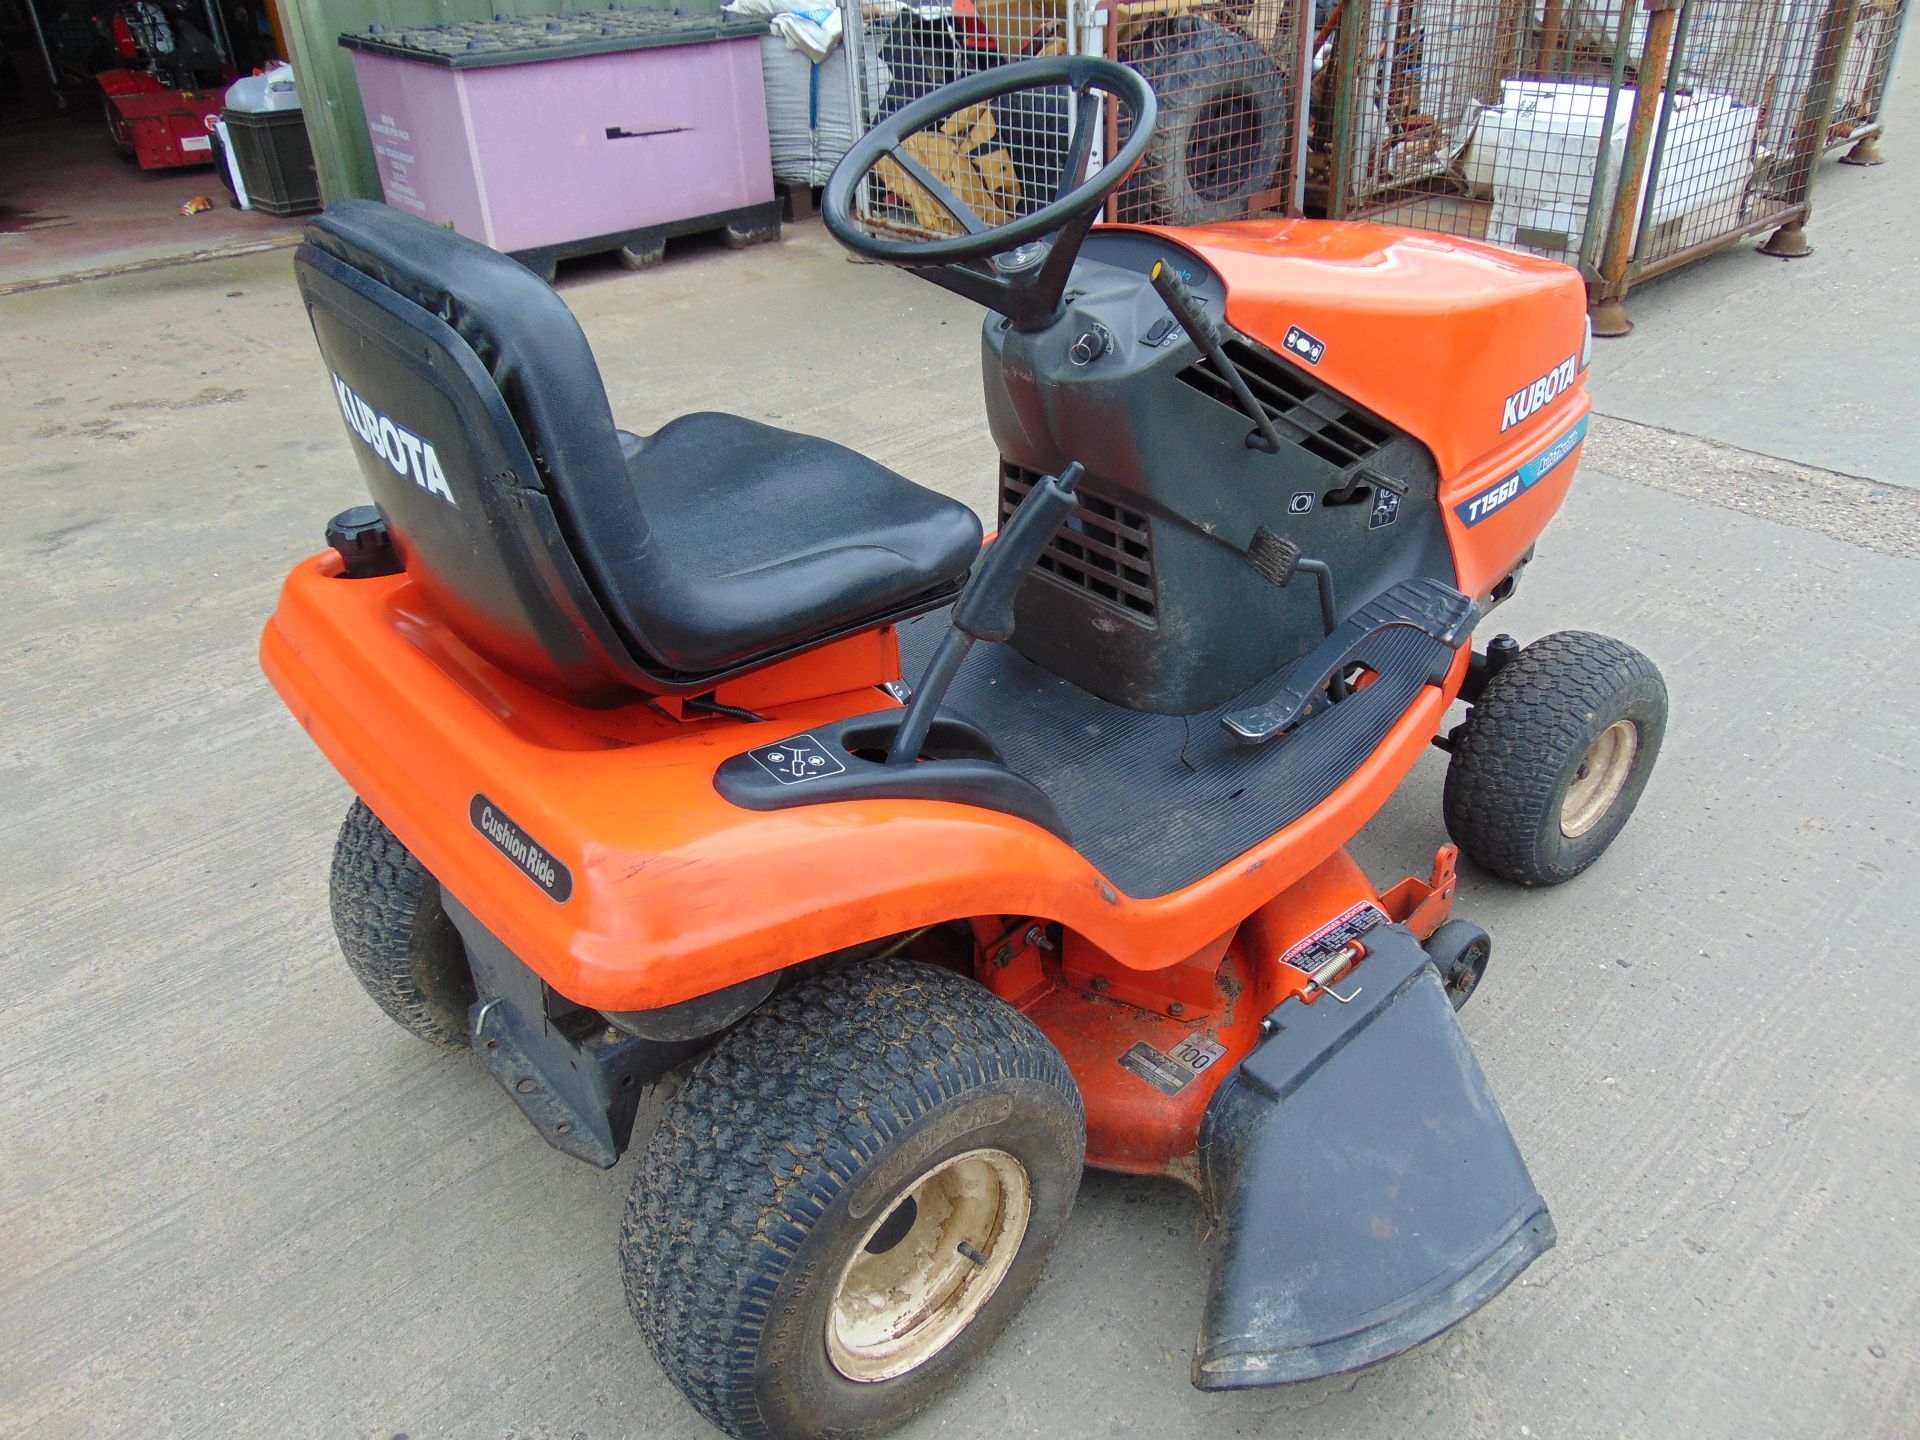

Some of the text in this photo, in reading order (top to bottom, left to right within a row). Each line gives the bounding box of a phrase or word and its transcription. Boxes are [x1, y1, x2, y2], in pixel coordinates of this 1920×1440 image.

[1500, 354, 1576, 433] KUBOTA
[332, 370, 457, 505] KUBOTA
[1468, 475, 1520, 522] T1560
[481, 806, 556, 888] Cushion Ride
[1288, 938, 1315, 961] DANGER
[1317, 919, 1342, 941] DANGER
[1177, 1042, 1211, 1069] 100
